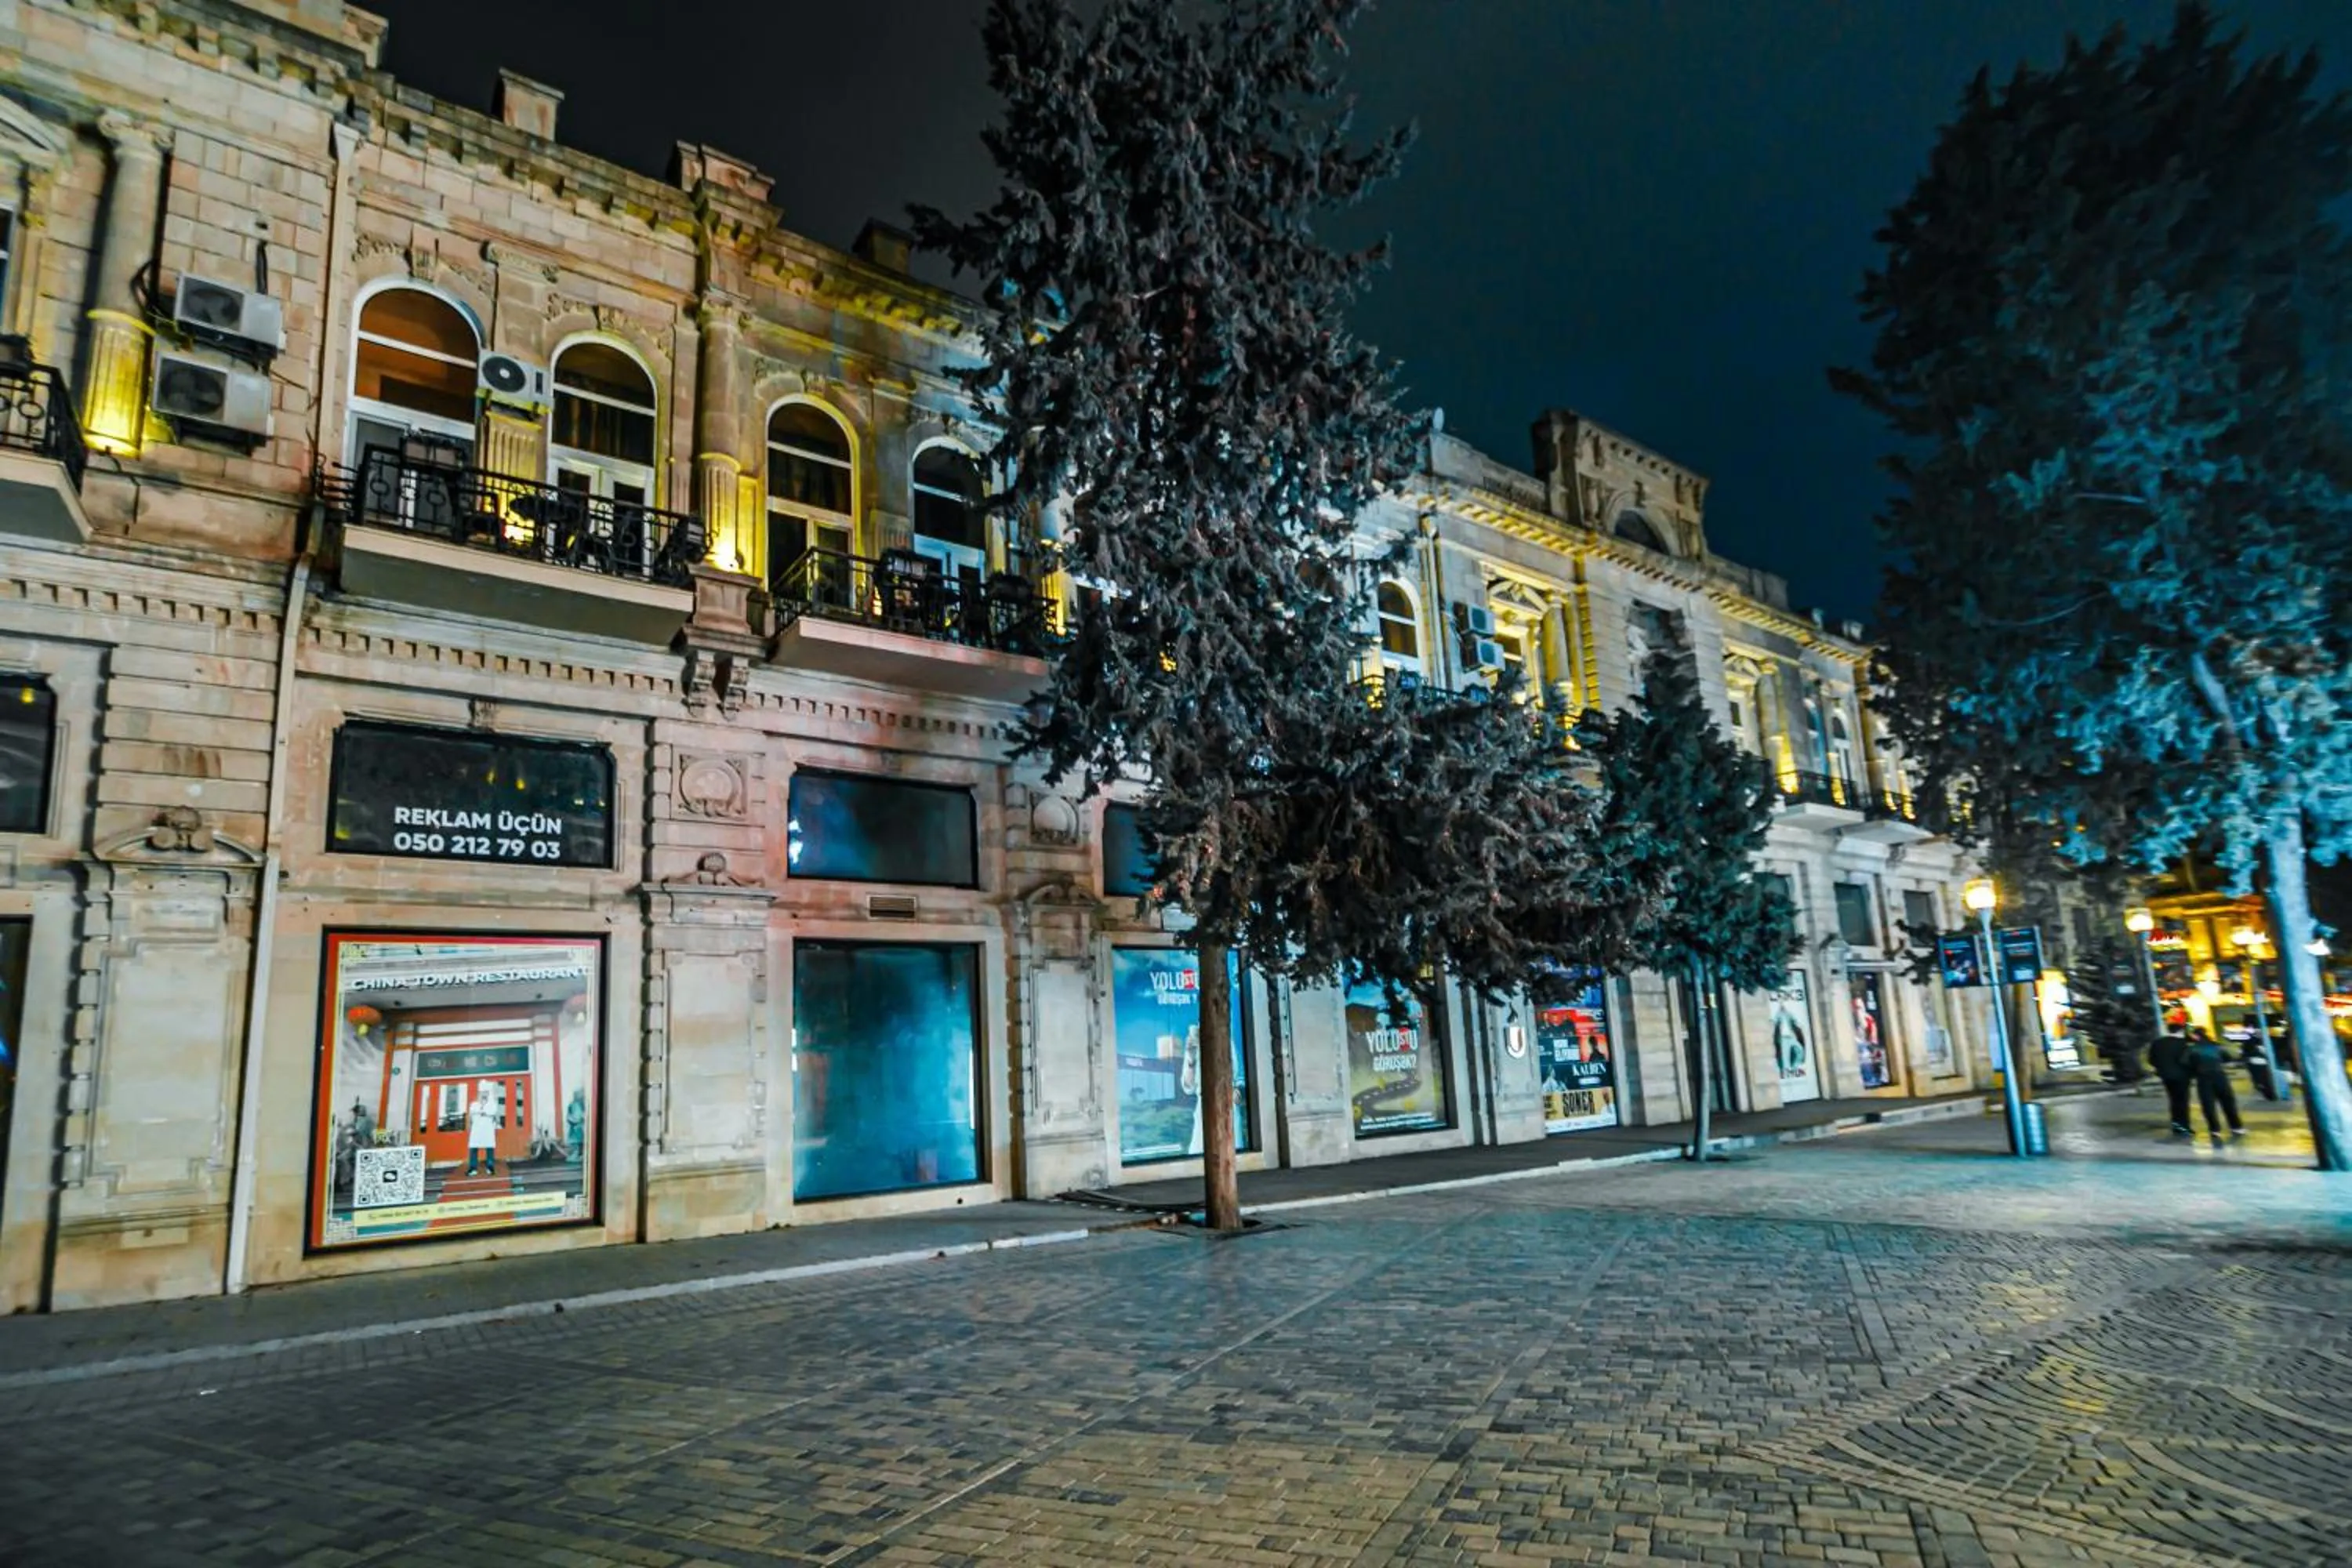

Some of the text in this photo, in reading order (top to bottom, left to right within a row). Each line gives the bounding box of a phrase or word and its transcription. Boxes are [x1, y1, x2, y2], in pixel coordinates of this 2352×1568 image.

[394, 806, 562, 837] REKLAM ÜÇÜN
[394, 832, 561, 859] 050 212 79 03
[351, 977, 408, 991] CHINA
[411, 973, 470, 988] TOWN
